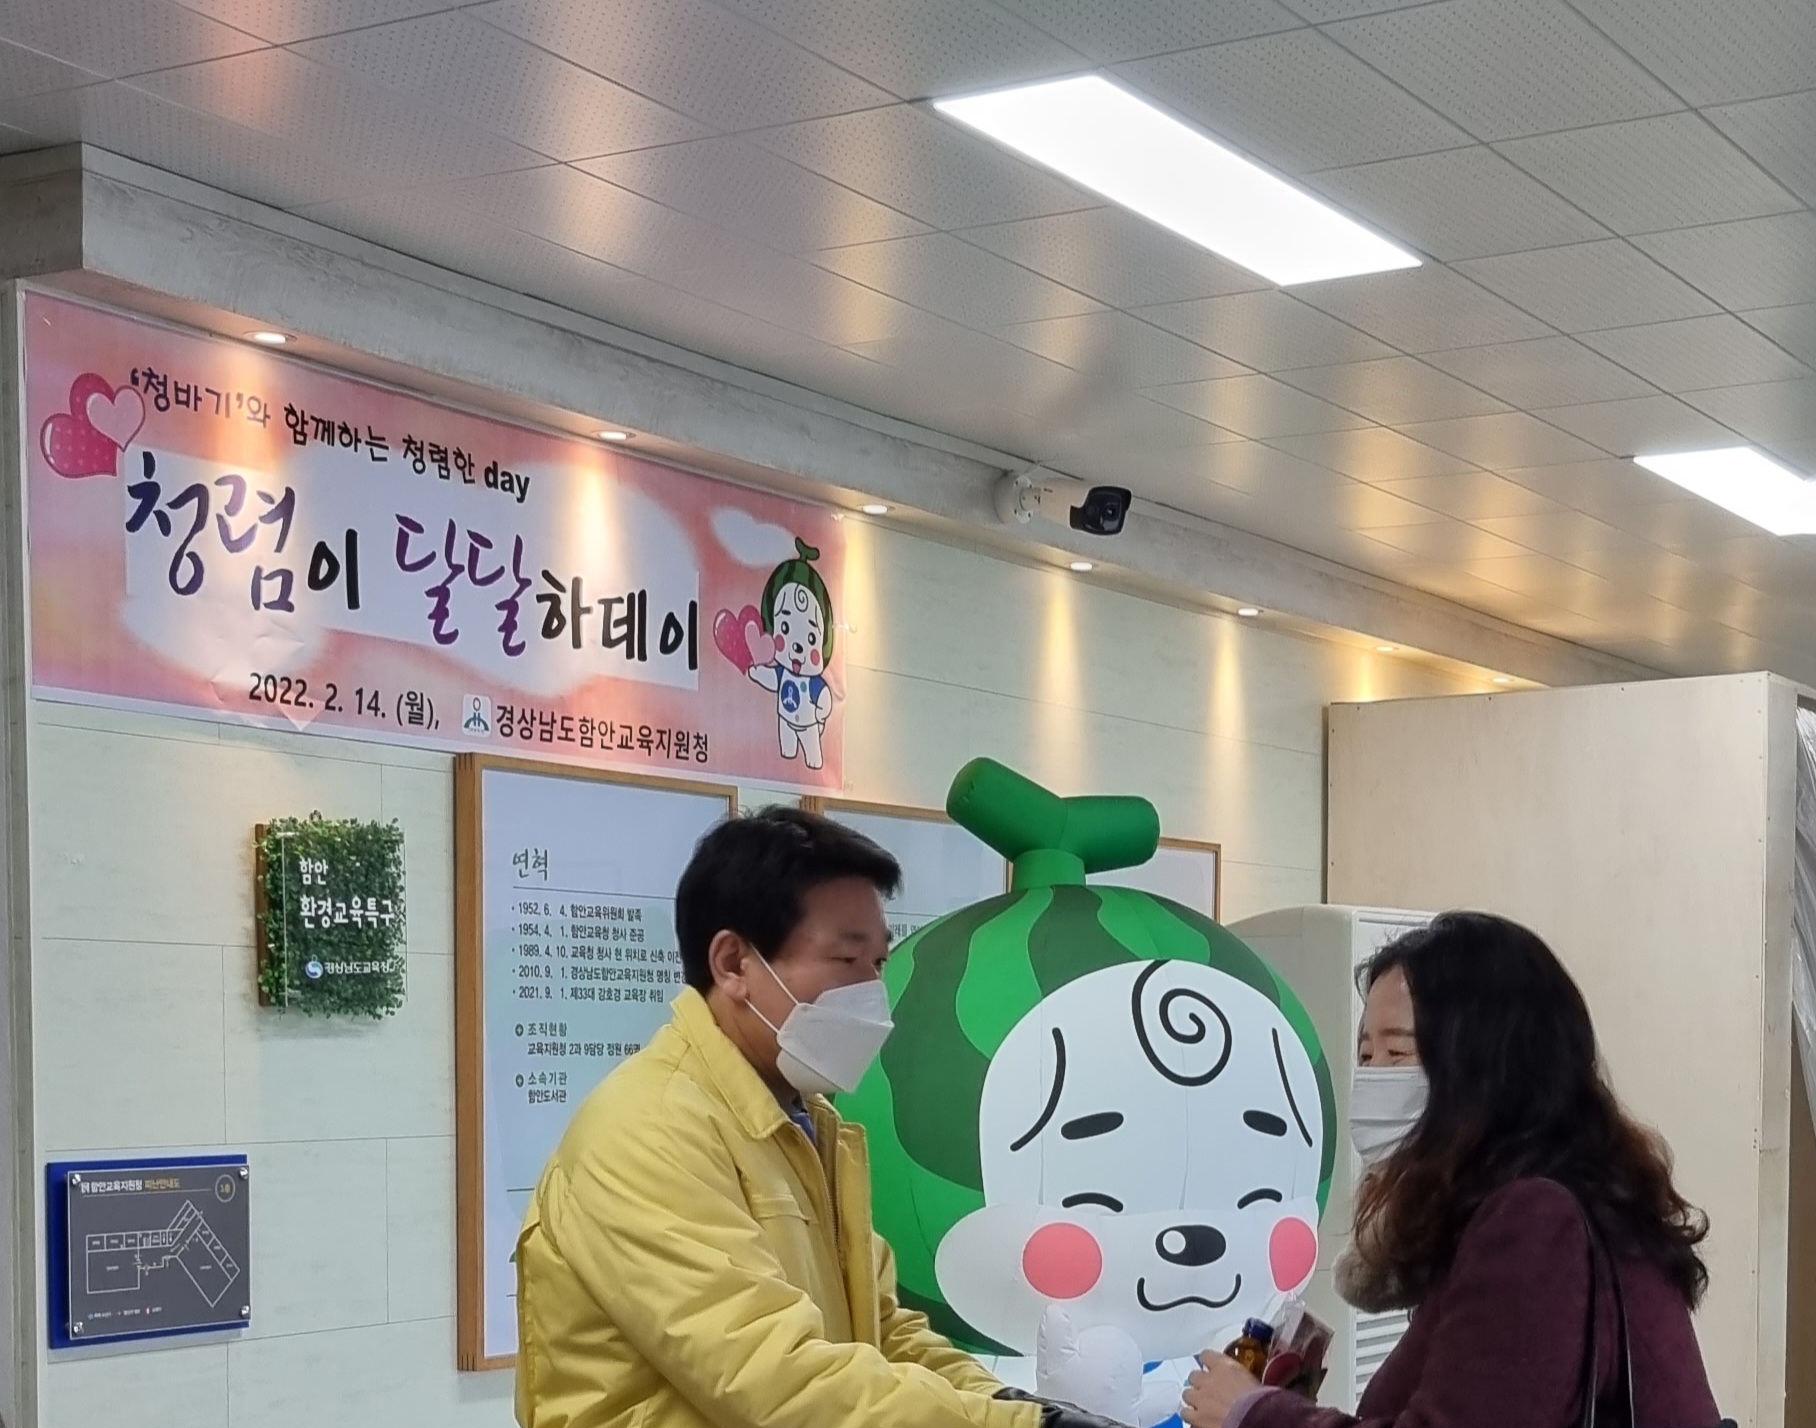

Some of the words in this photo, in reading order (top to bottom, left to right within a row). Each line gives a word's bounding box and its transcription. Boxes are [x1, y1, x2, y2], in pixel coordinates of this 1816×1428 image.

[283, 402, 389, 462] 함께하는
[401, 434, 475, 485] 청렴한
[483, 461, 531, 503] day
[125, 450, 360, 613] 청렴이
[395, 513, 698, 671] 달달하데이
[248, 672, 314, 708] 2022.
[324, 683, 343, 713] 2.
[354, 688, 386, 719] 14.
[395, 690, 440, 729] (월),
[495, 703, 709, 764] 경상남도함안교육지원청
[299, 858, 328, 885] 함안
[512, 847, 548, 881] 연혁
[300, 894, 395, 929] 환경교육특구
[559, 904, 568, 918] 4.
[570, 903, 625, 922] 함안교육위원회
[626, 907, 642, 922] 발족
[518, 923, 542, 938] 1954.
[544, 924, 553, 938] 4.
[560, 926, 568, 939] 1.
[570, 924, 610, 942] 함안교육청
[611, 926, 627, 942] 청사
[629, 928, 645, 943] 준공
[518, 943, 542, 958] 1989.
[544, 945, 553, 958] 4.
[556, 945, 568, 959] 10.
[570, 946, 594, 961] 교육청
[596, 946, 612, 961] 청사
[614, 947, 623, 962] 현
[625, 948, 648, 963] 위치로
[650, 949, 665, 964] 신축
[324, 960, 390, 975] 경상남도교육청
[518, 964, 543, 979] 2010.
[544, 965, 553, 980] 9.
[560, 966, 568, 980] 1.
[570, 965, 655, 984] 경상남도함안교육지원청
[656, 969, 672, 984] 명칭
[518, 985, 543, 1000] 2021.
[544, 986, 553, 1000] 9.
[560, 986, 568, 1001] 1.
[570, 985, 597, 1002] 제33대
[623, 988, 647, 1004] 교육장
[649, 988, 665, 1004] 취임
[527, 1021, 568, 1038] 조직현황
[527, 1041, 567, 1057] 교육지원청
[568, 1042, 582, 1056] 2과
[583, 1042, 605, 1057] 9담당
[606, 1042, 622, 1057] 정원
[527, 1071, 568, 1087] 소속기관
[527, 1088, 568, 1105] 함안도서관
